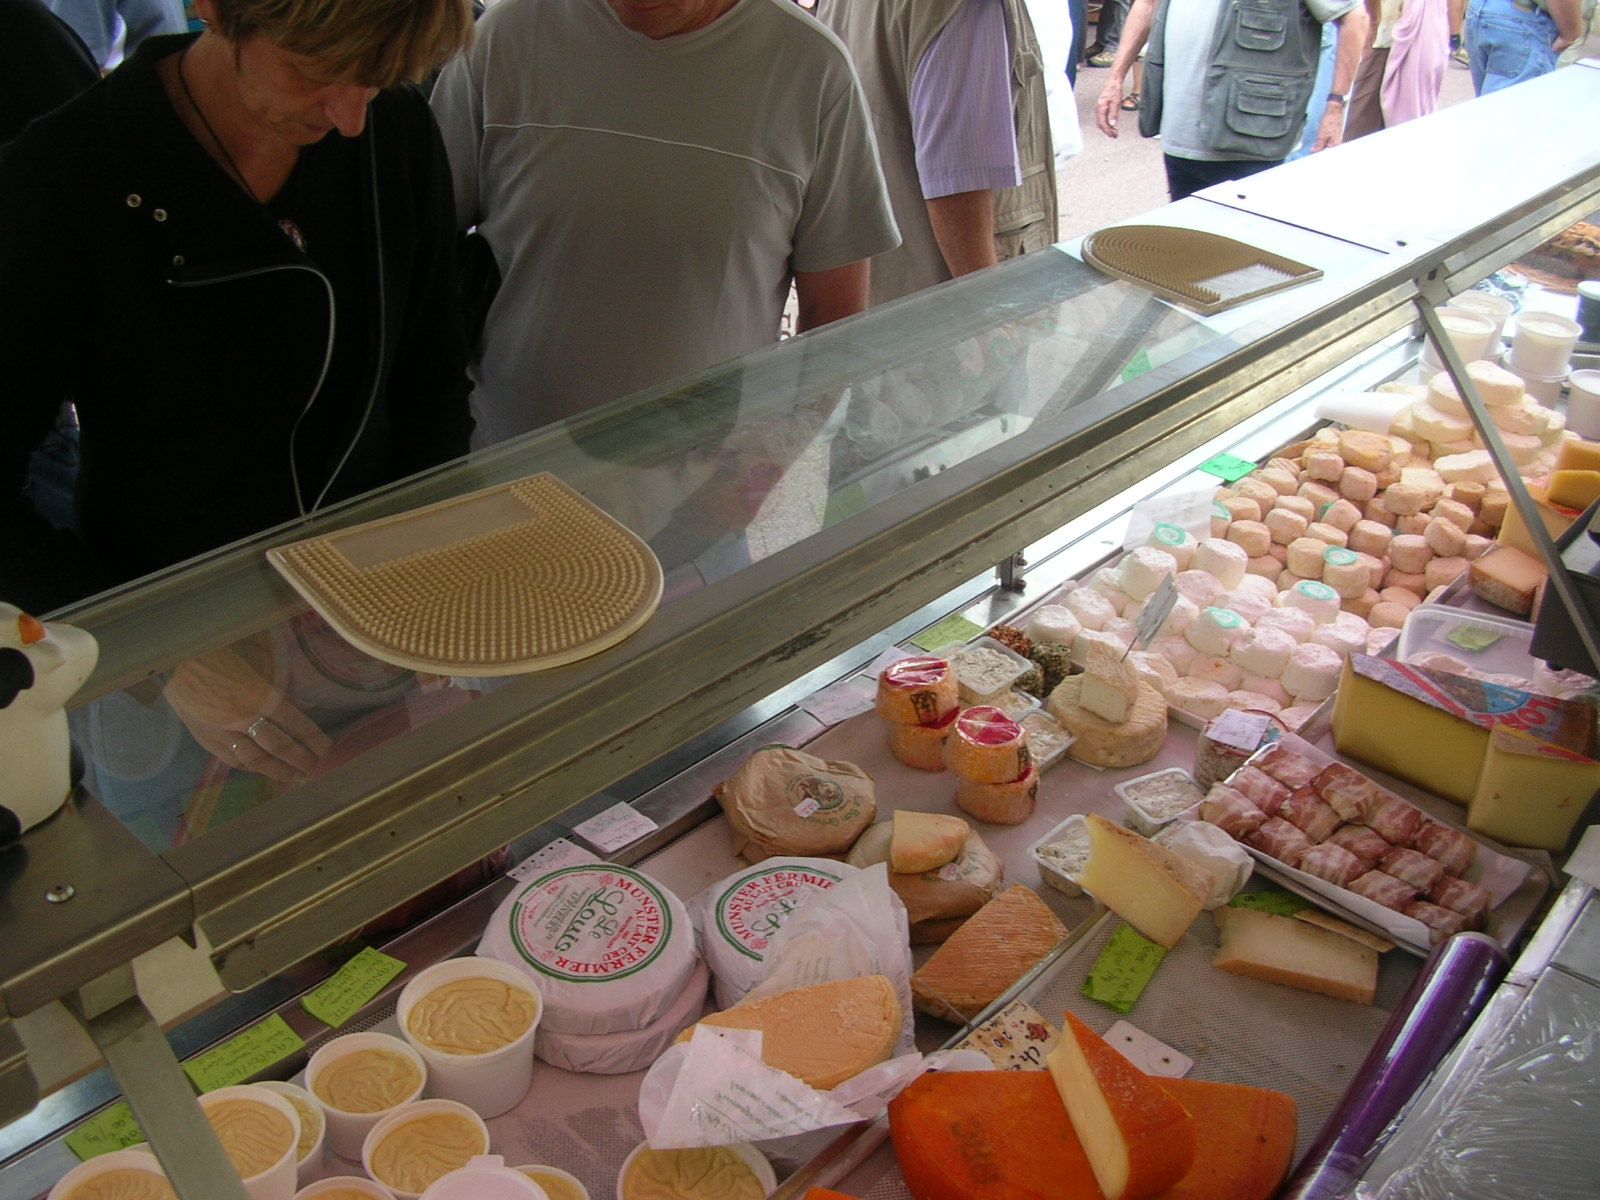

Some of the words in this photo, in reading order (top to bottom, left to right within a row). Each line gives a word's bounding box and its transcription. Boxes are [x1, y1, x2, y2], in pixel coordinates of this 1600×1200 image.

[616, 878, 660, 945] MUNSTER
[729, 882, 760, 941] MUNSTER
[743, 899, 753, 912] AU
[751, 885, 773, 899] LAIT
[555, 886, 625, 952] Louis
[589, 915, 619, 939] Le
[634, 908, 645, 921] AU
[627, 924, 646, 948] LAIT
[555, 945, 648, 975] FERMIER
[602, 946, 629, 962] CRU
